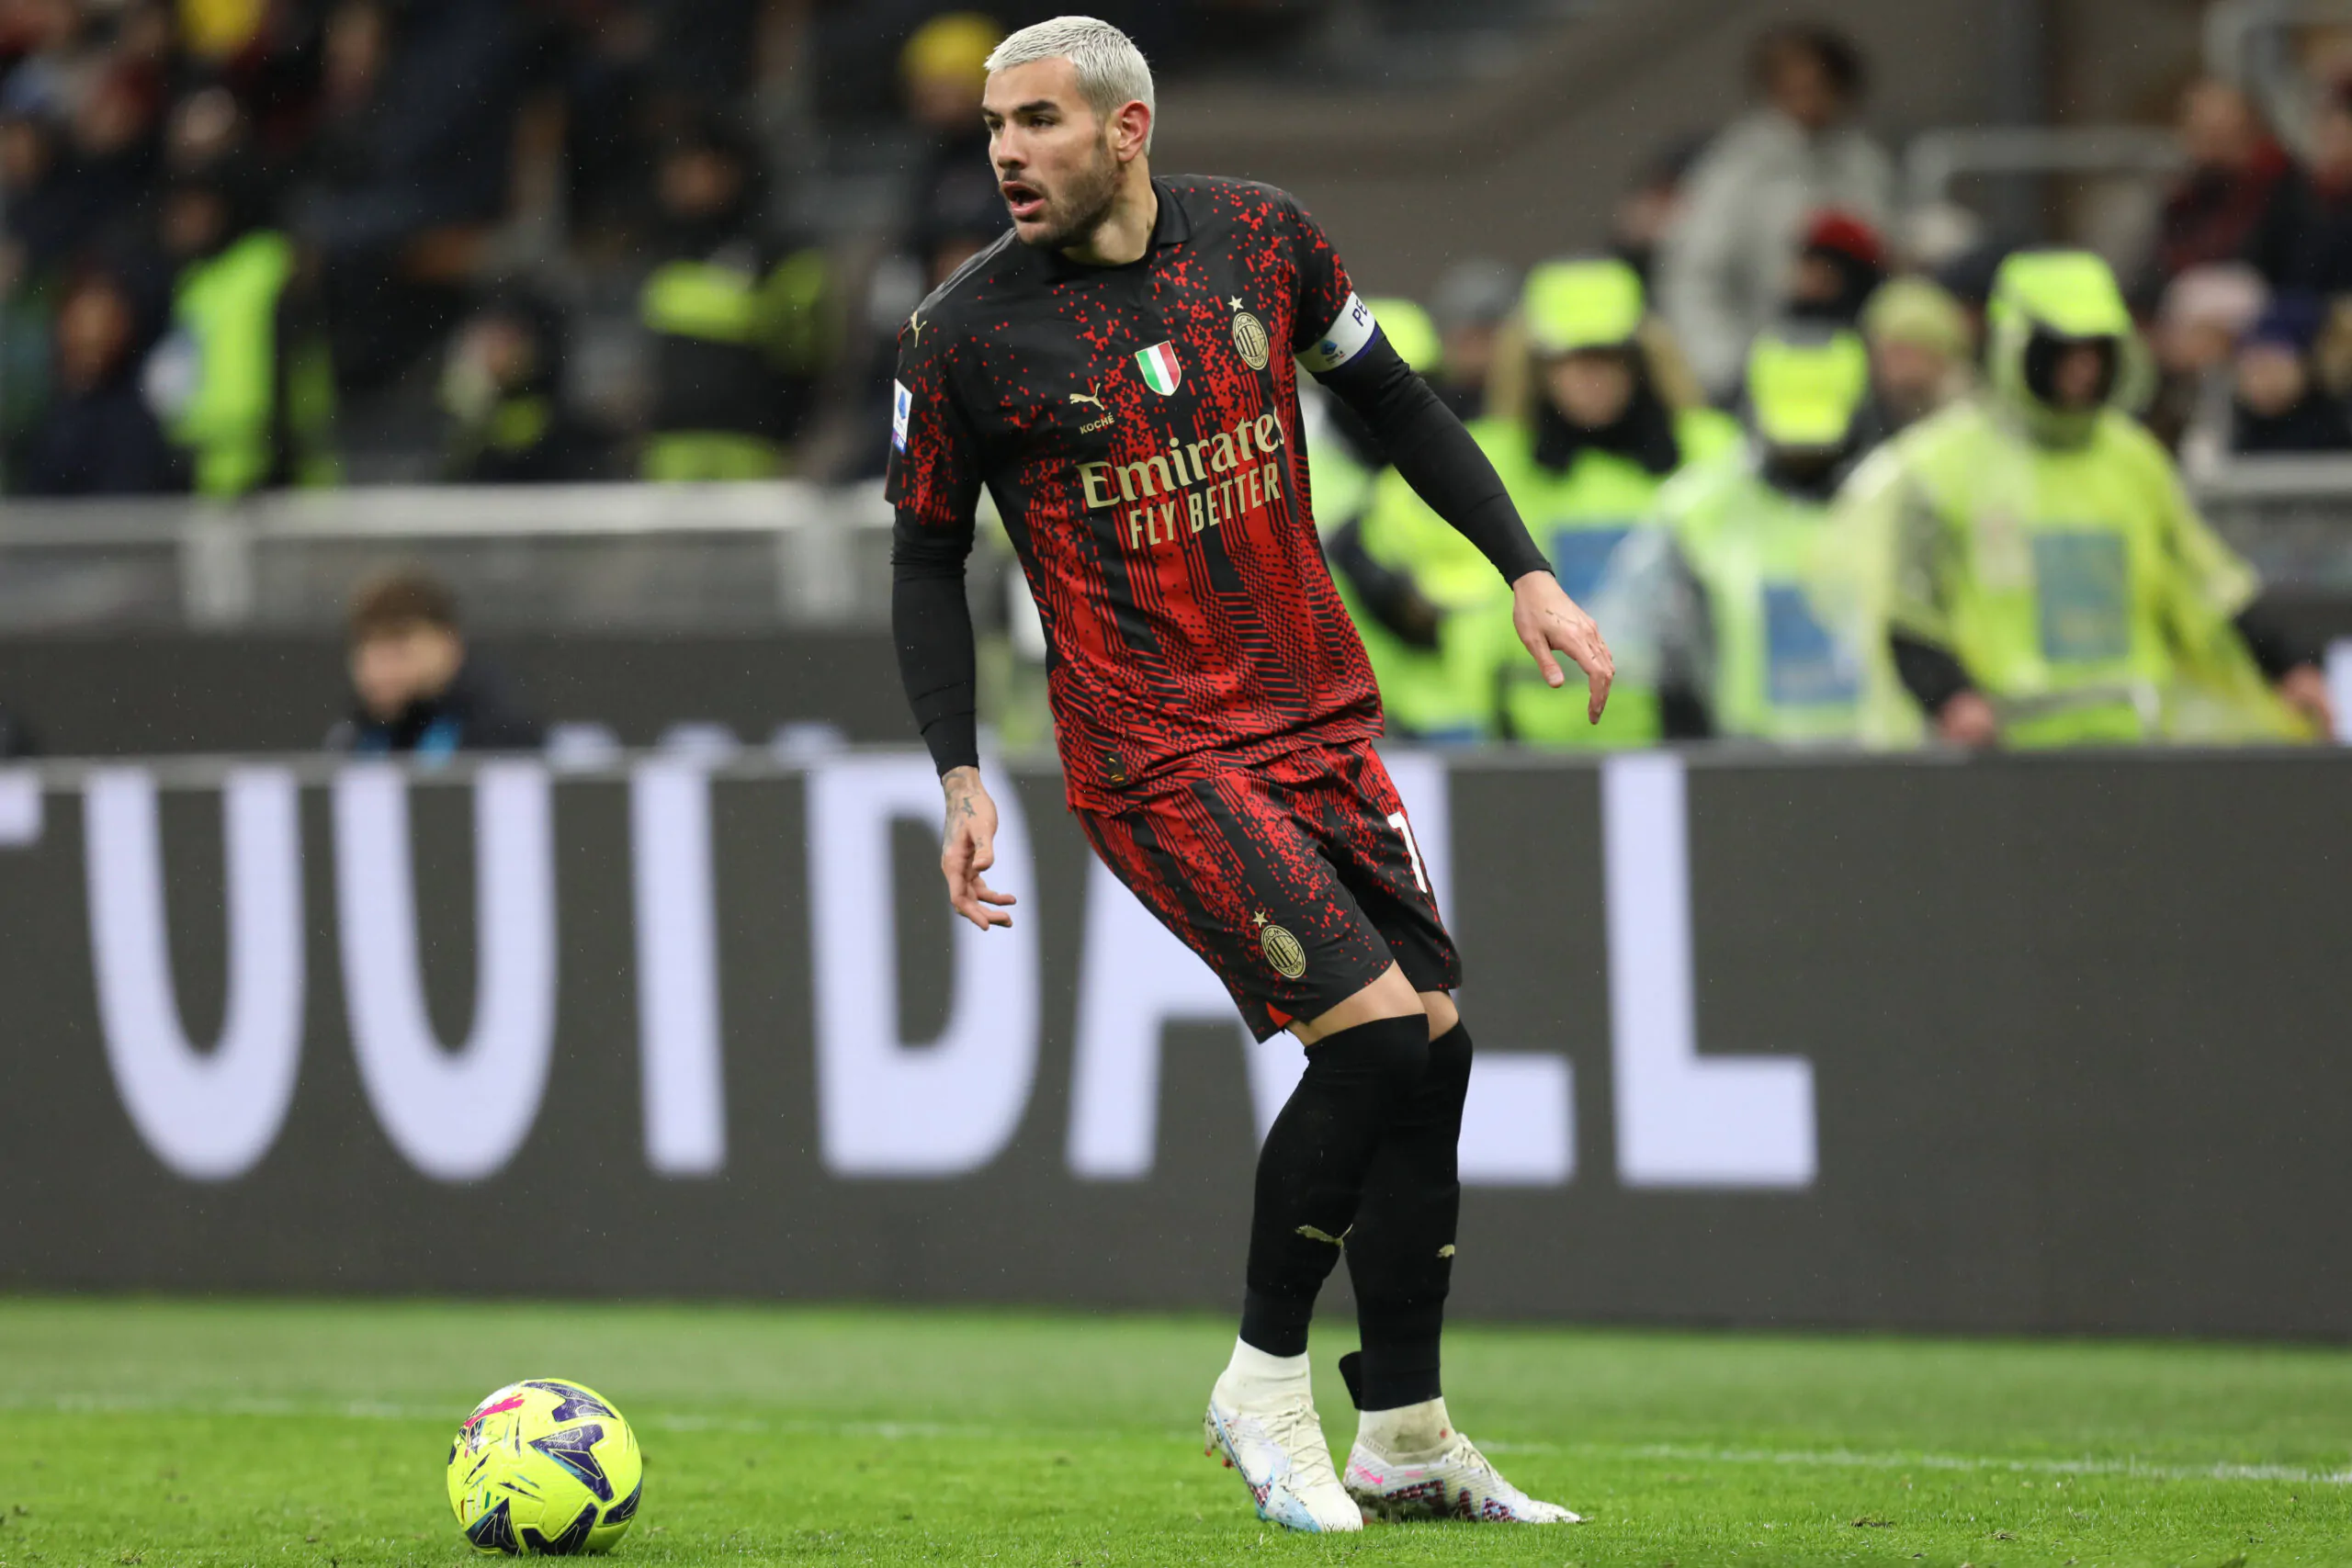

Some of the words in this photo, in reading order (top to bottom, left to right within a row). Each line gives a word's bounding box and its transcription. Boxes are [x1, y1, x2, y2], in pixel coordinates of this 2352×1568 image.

[1250, 354, 1265, 365] 1899
[1080, 412, 1115, 434] KOCHÉ
[1129, 502, 1175, 549] FLY
[1188, 462, 1282, 534] BETTER
[1265, 929, 1283, 943] ACM
[1286, 960, 1302, 974] 1899
